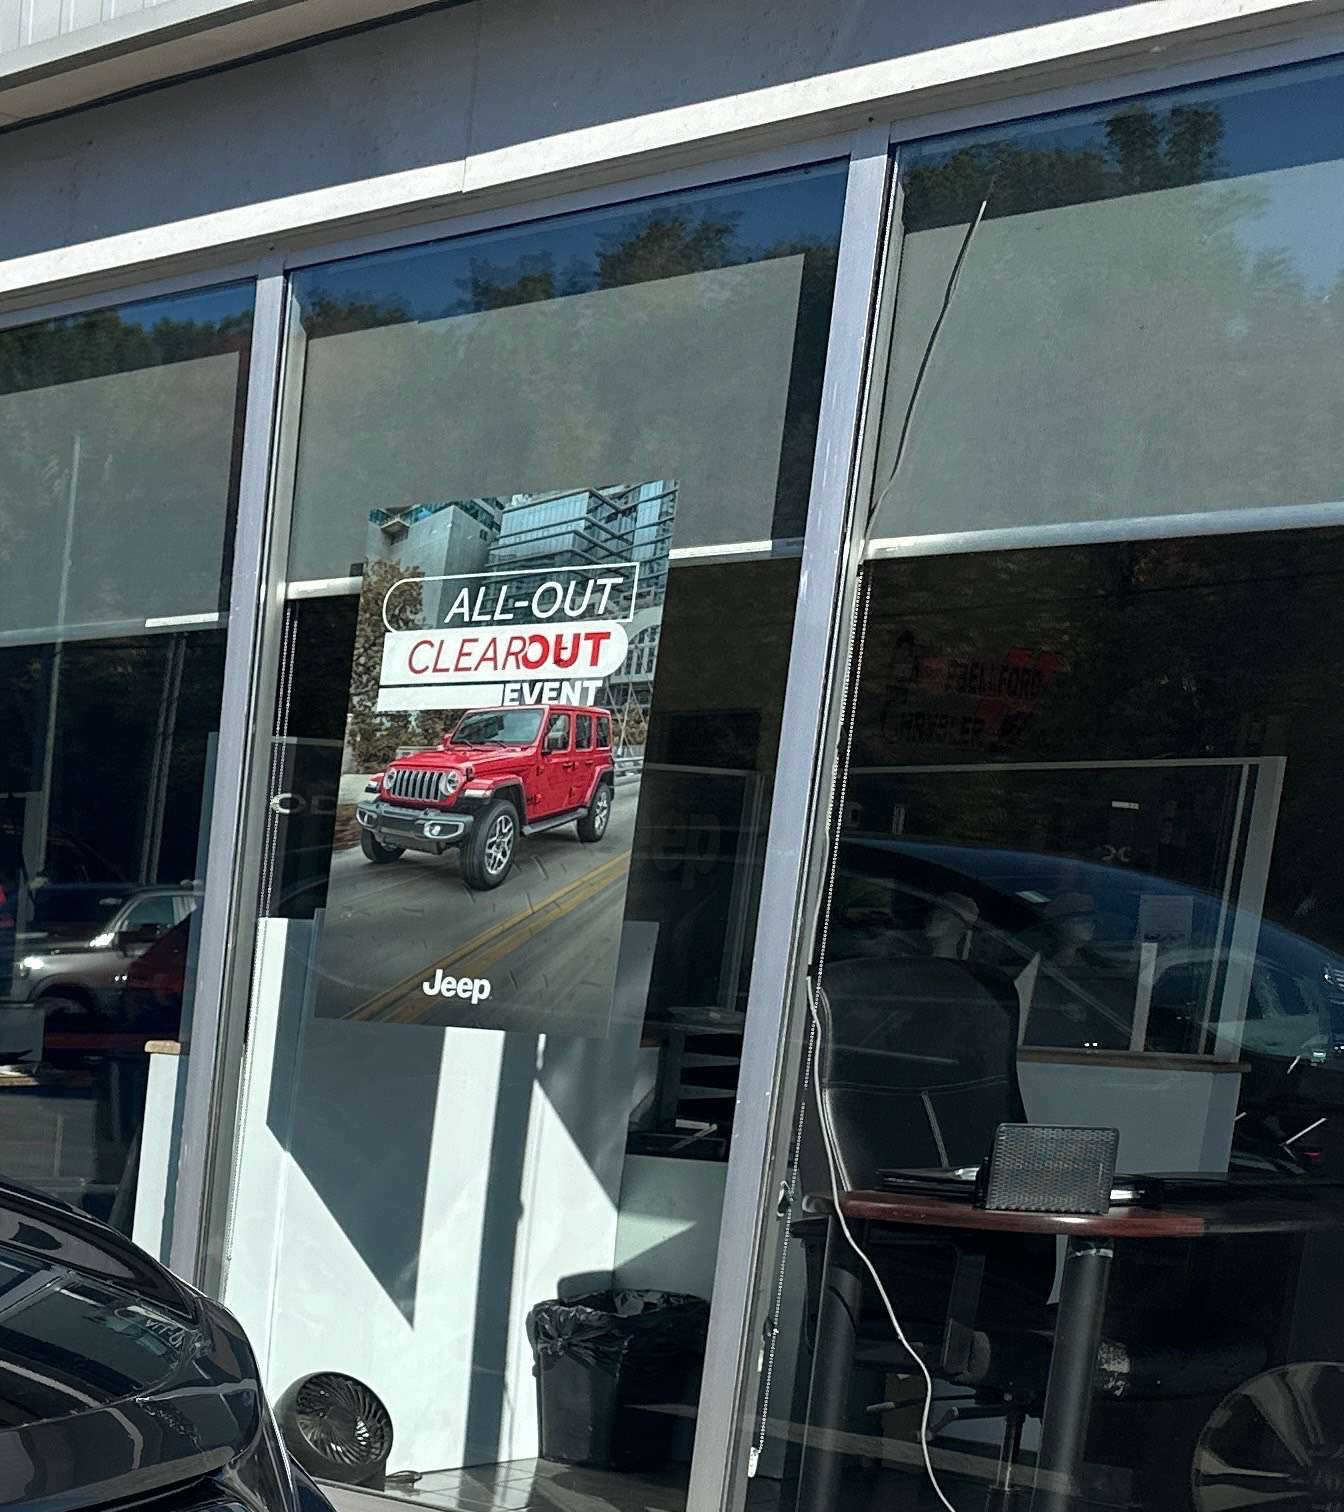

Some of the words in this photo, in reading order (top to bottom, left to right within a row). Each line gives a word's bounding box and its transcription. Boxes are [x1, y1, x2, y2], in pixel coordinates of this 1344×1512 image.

[444, 578, 623, 623] ALL-OUT
[408, 631, 612, 675] CLEAROUT
[502, 680, 604, 707] EVENT
[422, 968, 491, 1005] Jeep
